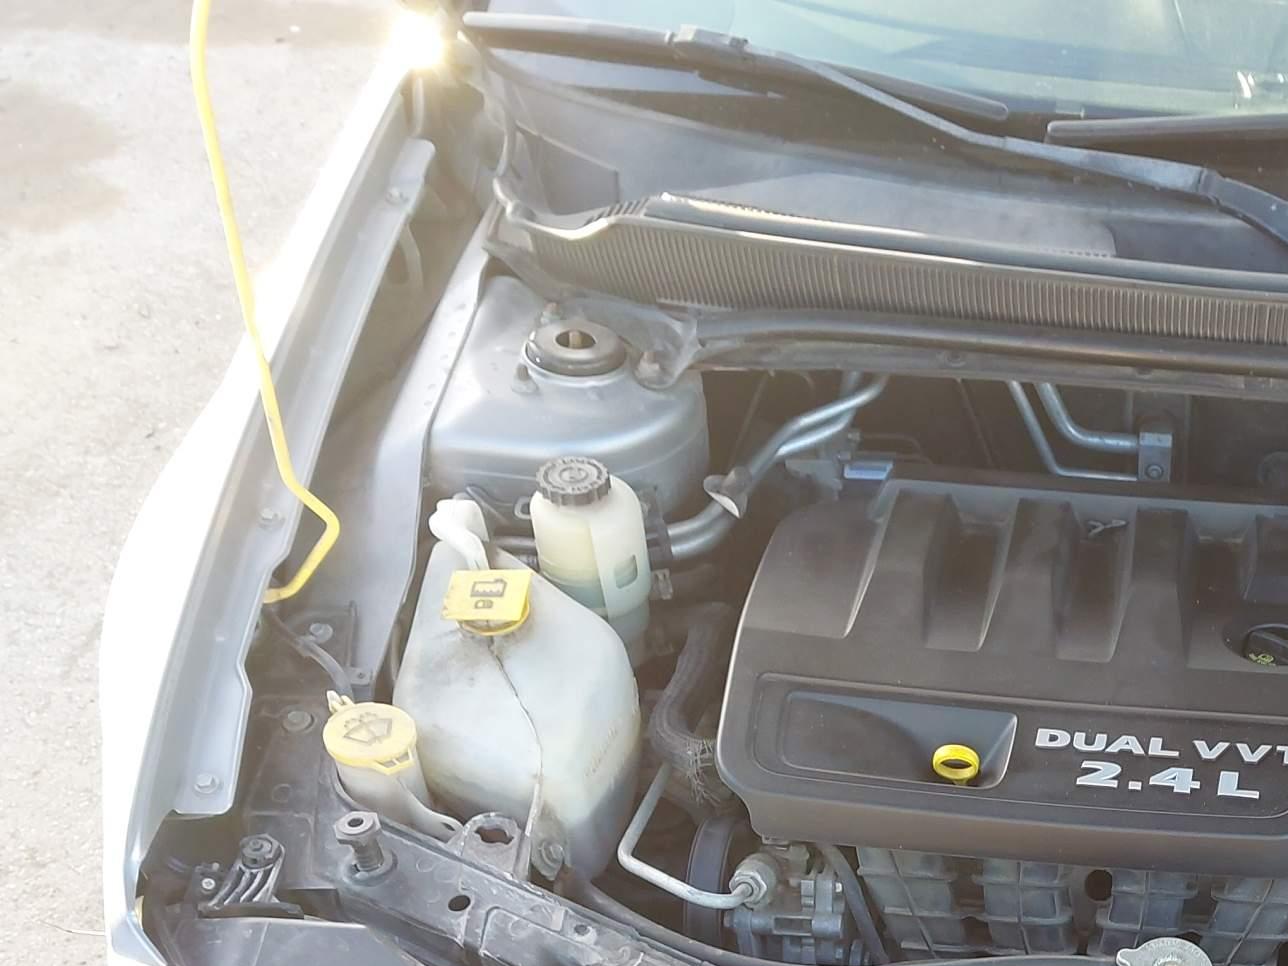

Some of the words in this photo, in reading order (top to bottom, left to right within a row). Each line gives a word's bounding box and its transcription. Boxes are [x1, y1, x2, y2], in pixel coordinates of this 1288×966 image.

[1034, 727, 1180, 758] DUAL
[1076, 760, 1201, 794] 2.4
[1217, 770, 1260, 800] L
